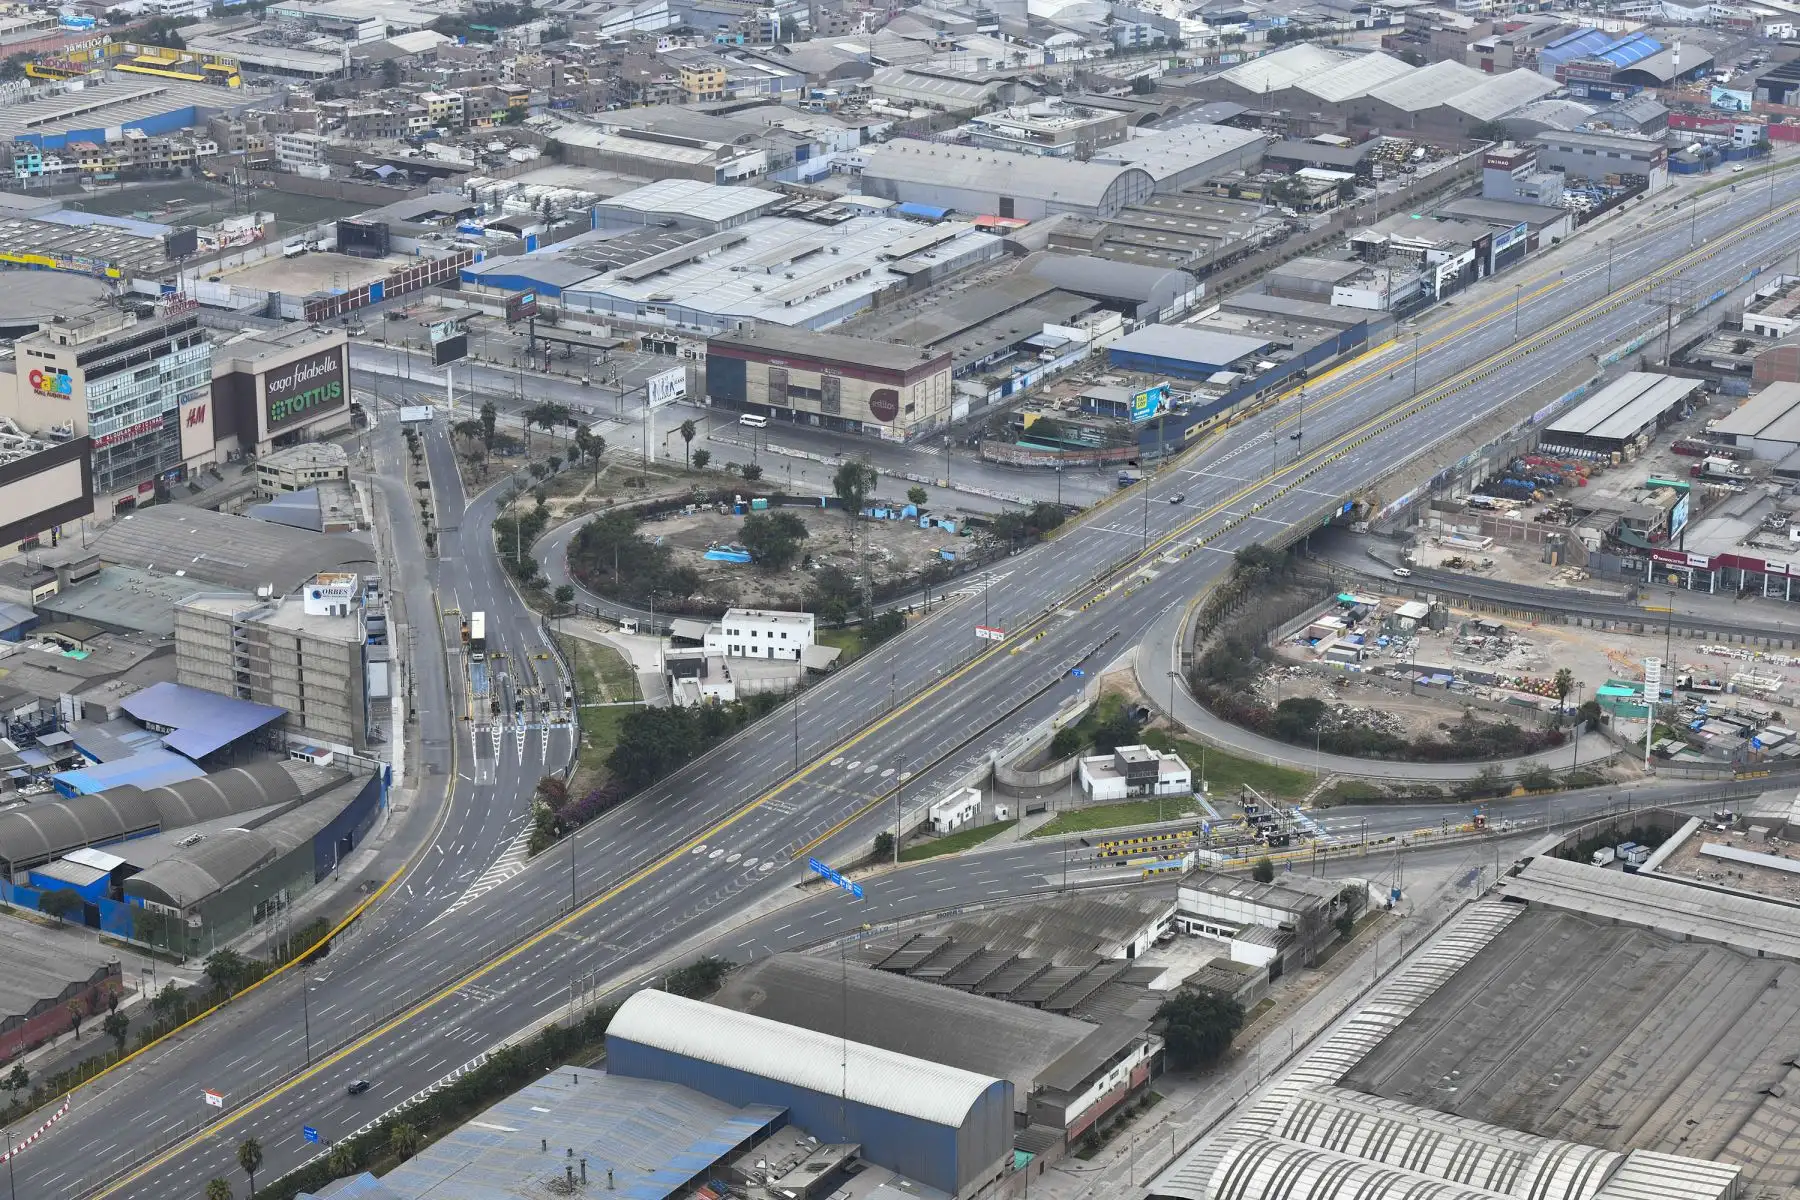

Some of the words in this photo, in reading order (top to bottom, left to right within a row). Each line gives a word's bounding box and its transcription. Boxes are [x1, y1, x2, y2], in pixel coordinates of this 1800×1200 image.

[268, 376, 292, 394] saga
[284, 381, 341, 415] TOTTUS
[186, 404, 206, 429] H&M
